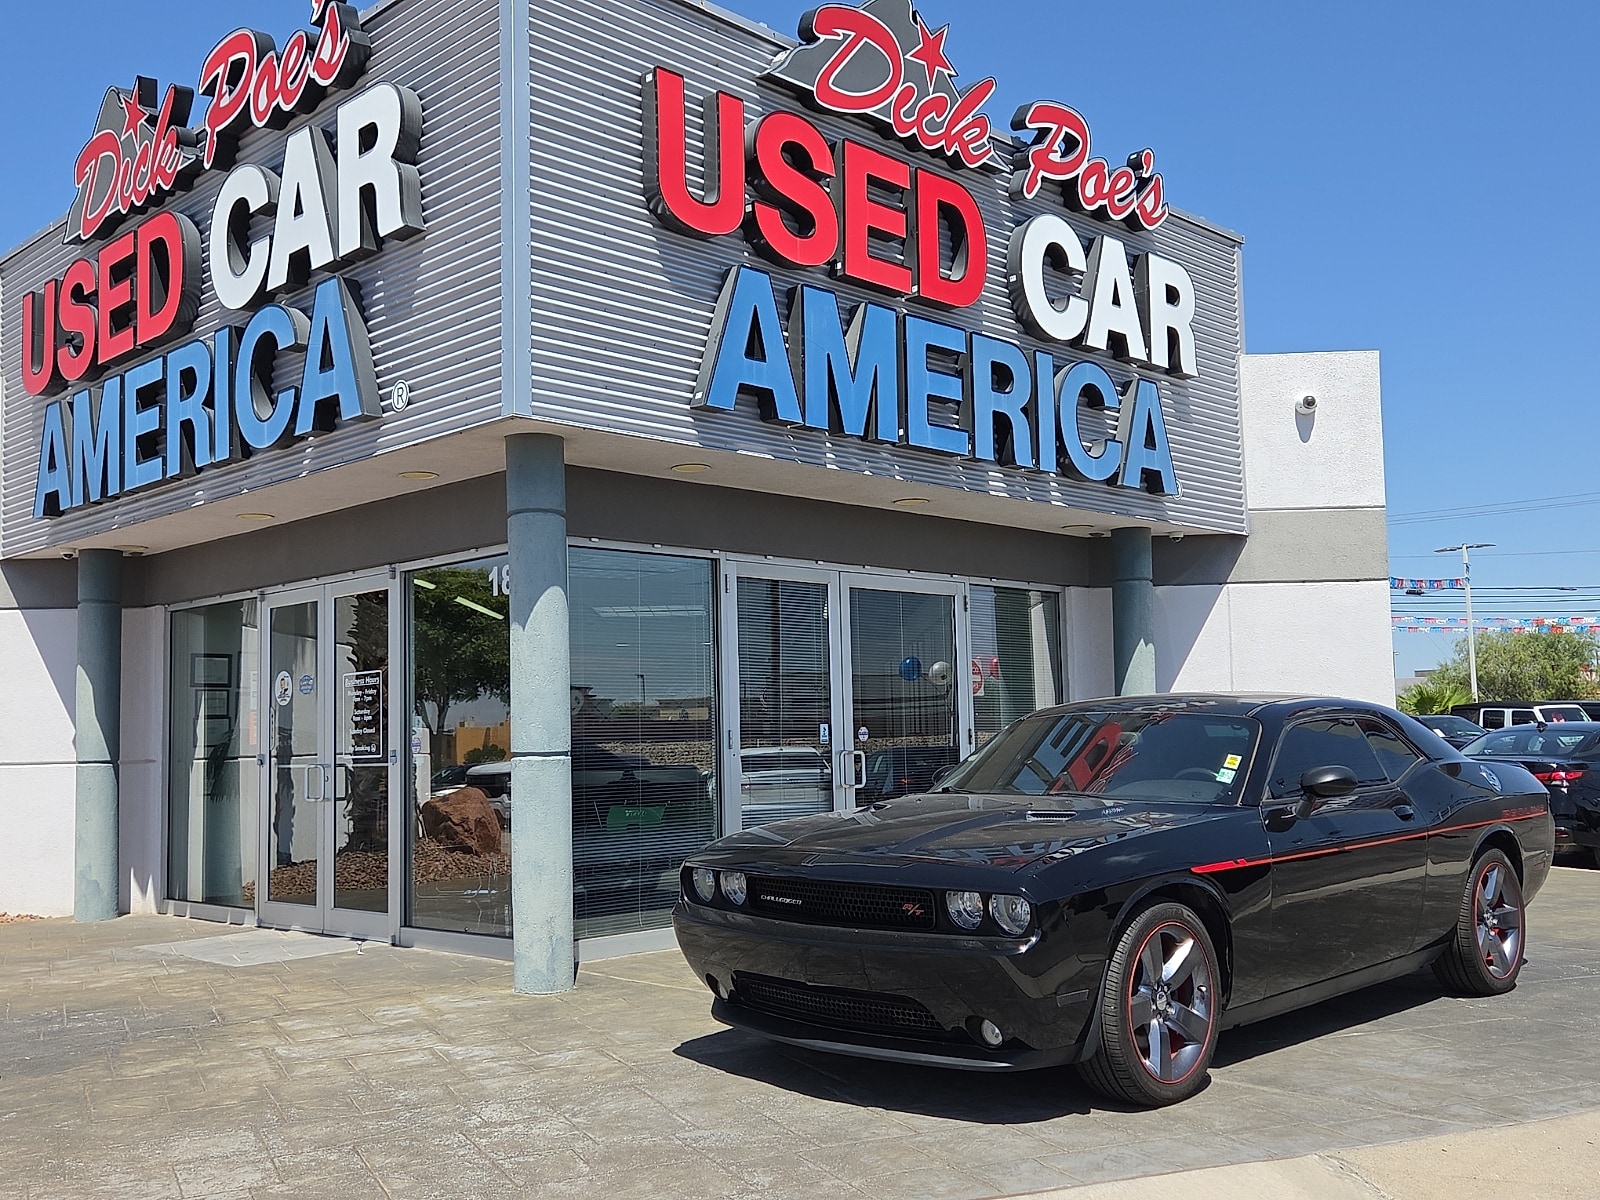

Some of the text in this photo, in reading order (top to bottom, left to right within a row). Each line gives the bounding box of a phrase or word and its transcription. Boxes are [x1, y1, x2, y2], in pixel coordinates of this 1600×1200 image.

[22, 81, 403, 396] USED CAR
[74, 0, 350, 240] Dick Poe's
[655, 66, 1199, 379] USED CAR
[813, 4, 1169, 231] Dick Poe's
[33, 274, 365, 519] AMERICA
[705, 264, 1180, 496] AMERICA
